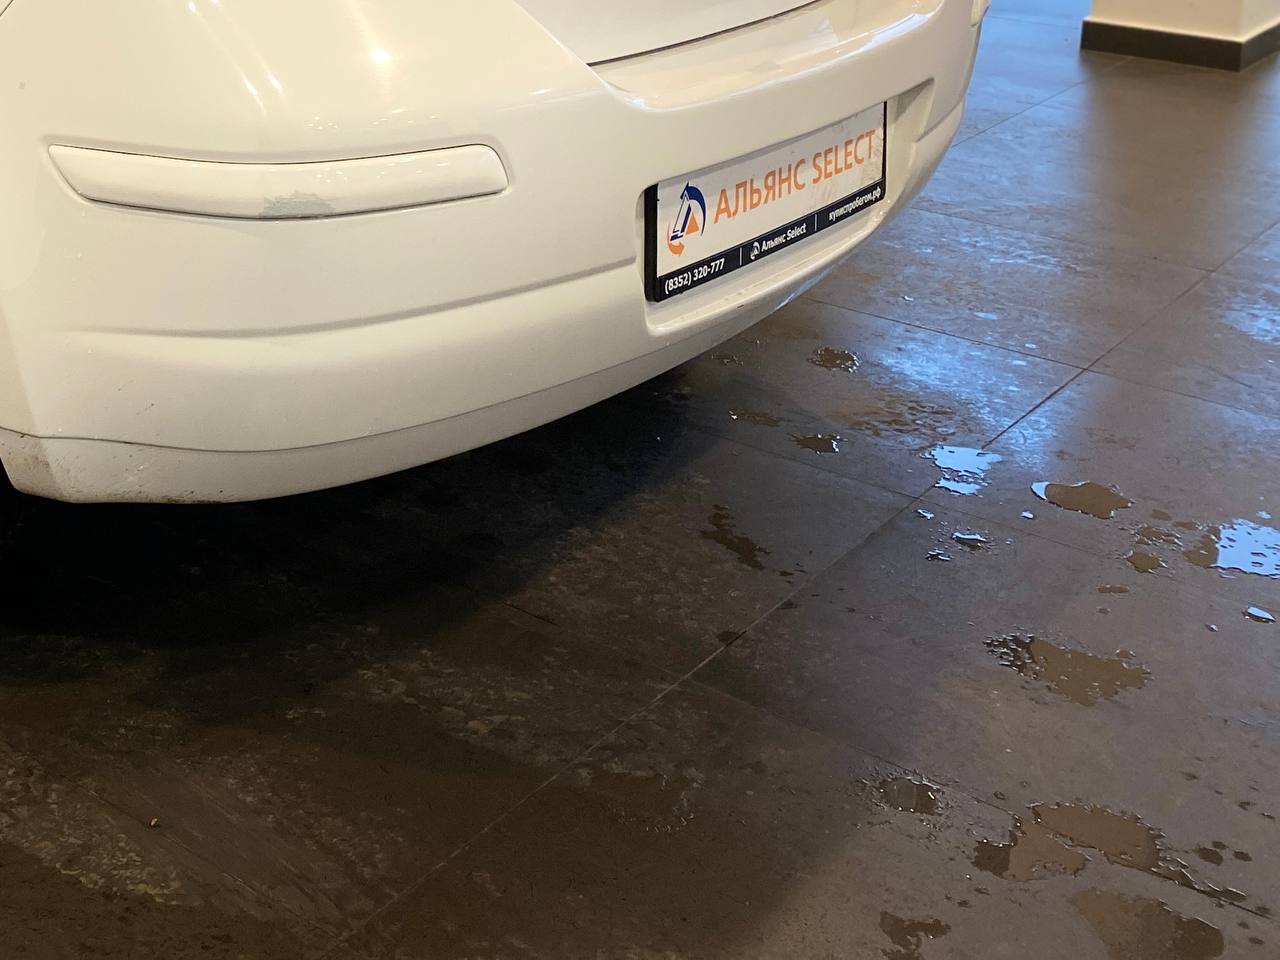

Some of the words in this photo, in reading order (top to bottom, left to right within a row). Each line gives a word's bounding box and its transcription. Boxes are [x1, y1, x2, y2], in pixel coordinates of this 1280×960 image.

[714, 159, 806, 224] АЛЬЯНС
[812, 129, 876, 184] SELECT
[665, 271, 692, 294] (8352)
[693, 258, 725, 281] 320-777
[761, 233, 786, 252] Альянс
[786, 223, 807, 240] Select
